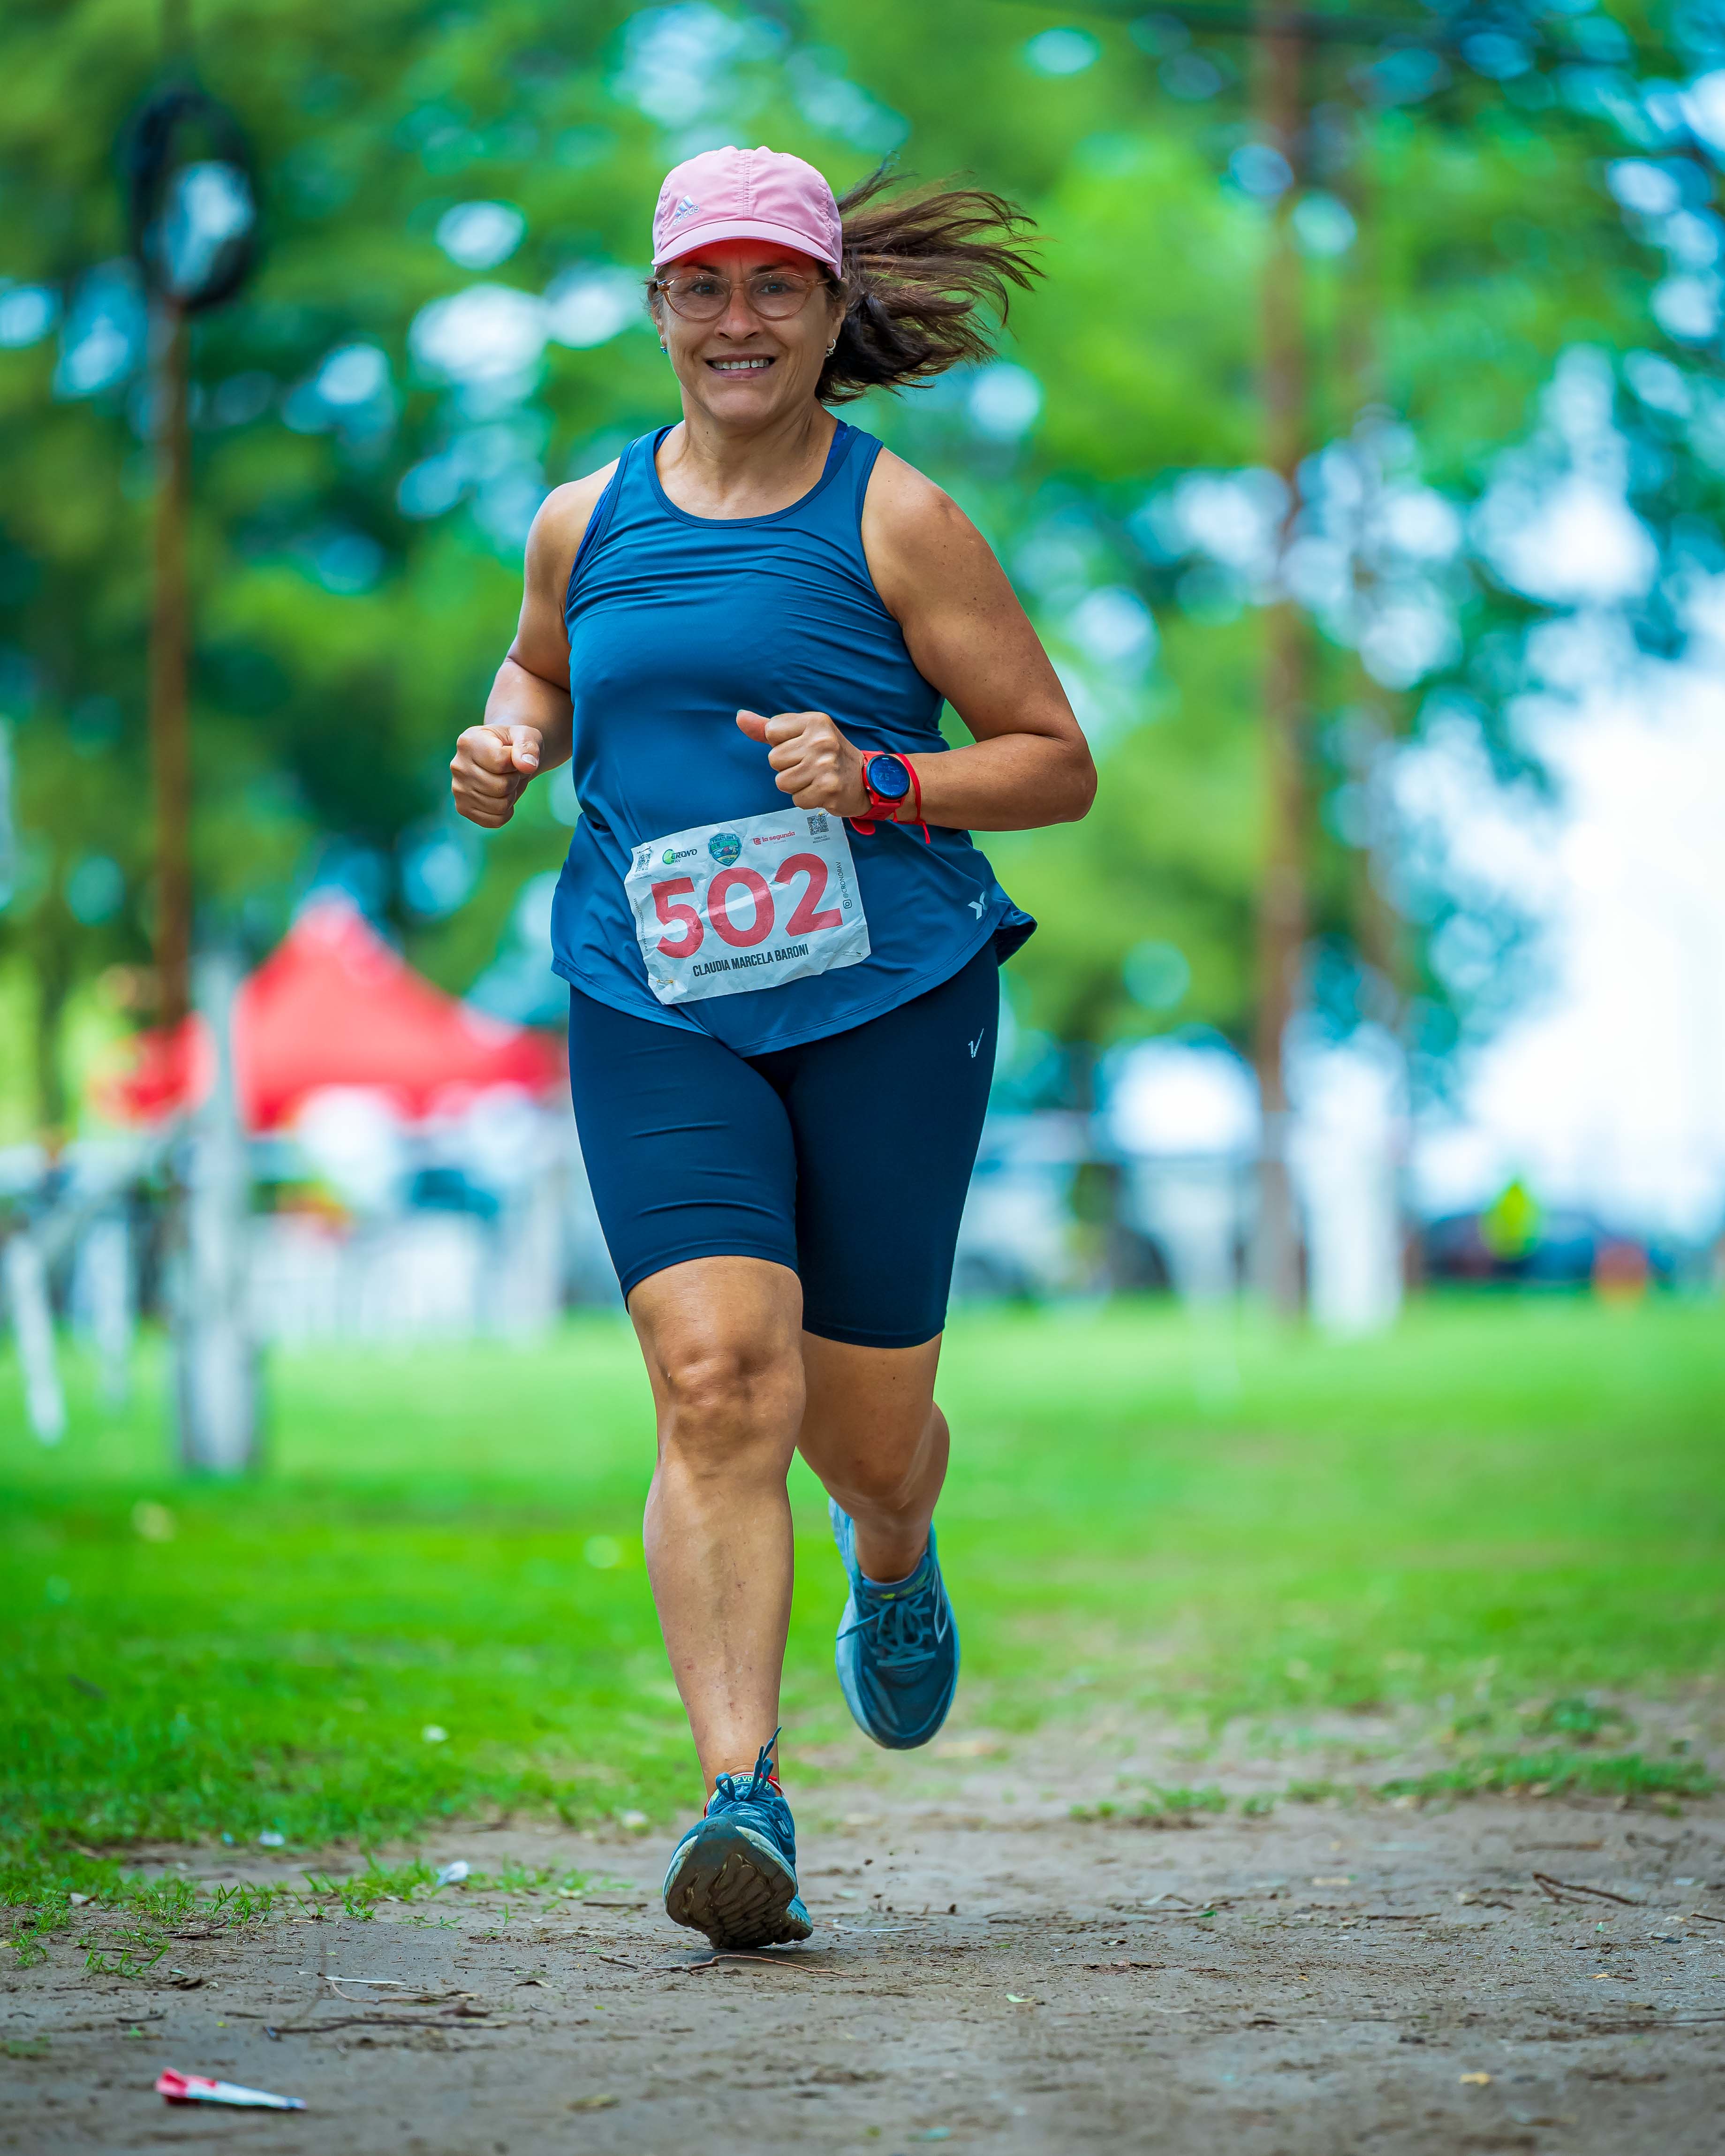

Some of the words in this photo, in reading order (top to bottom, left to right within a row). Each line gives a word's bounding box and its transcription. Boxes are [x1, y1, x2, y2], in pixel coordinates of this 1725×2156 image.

[673, 205, 699, 226] adidas
[769, 831, 795, 840] segunda
[836, 862, 849, 899] @CRONORAV
[651, 853, 843, 959] 502
[692, 959, 731, 977] CLAUDIA
[731, 951, 774, 969] MARCELA
[774, 944, 809, 961] BARONI
